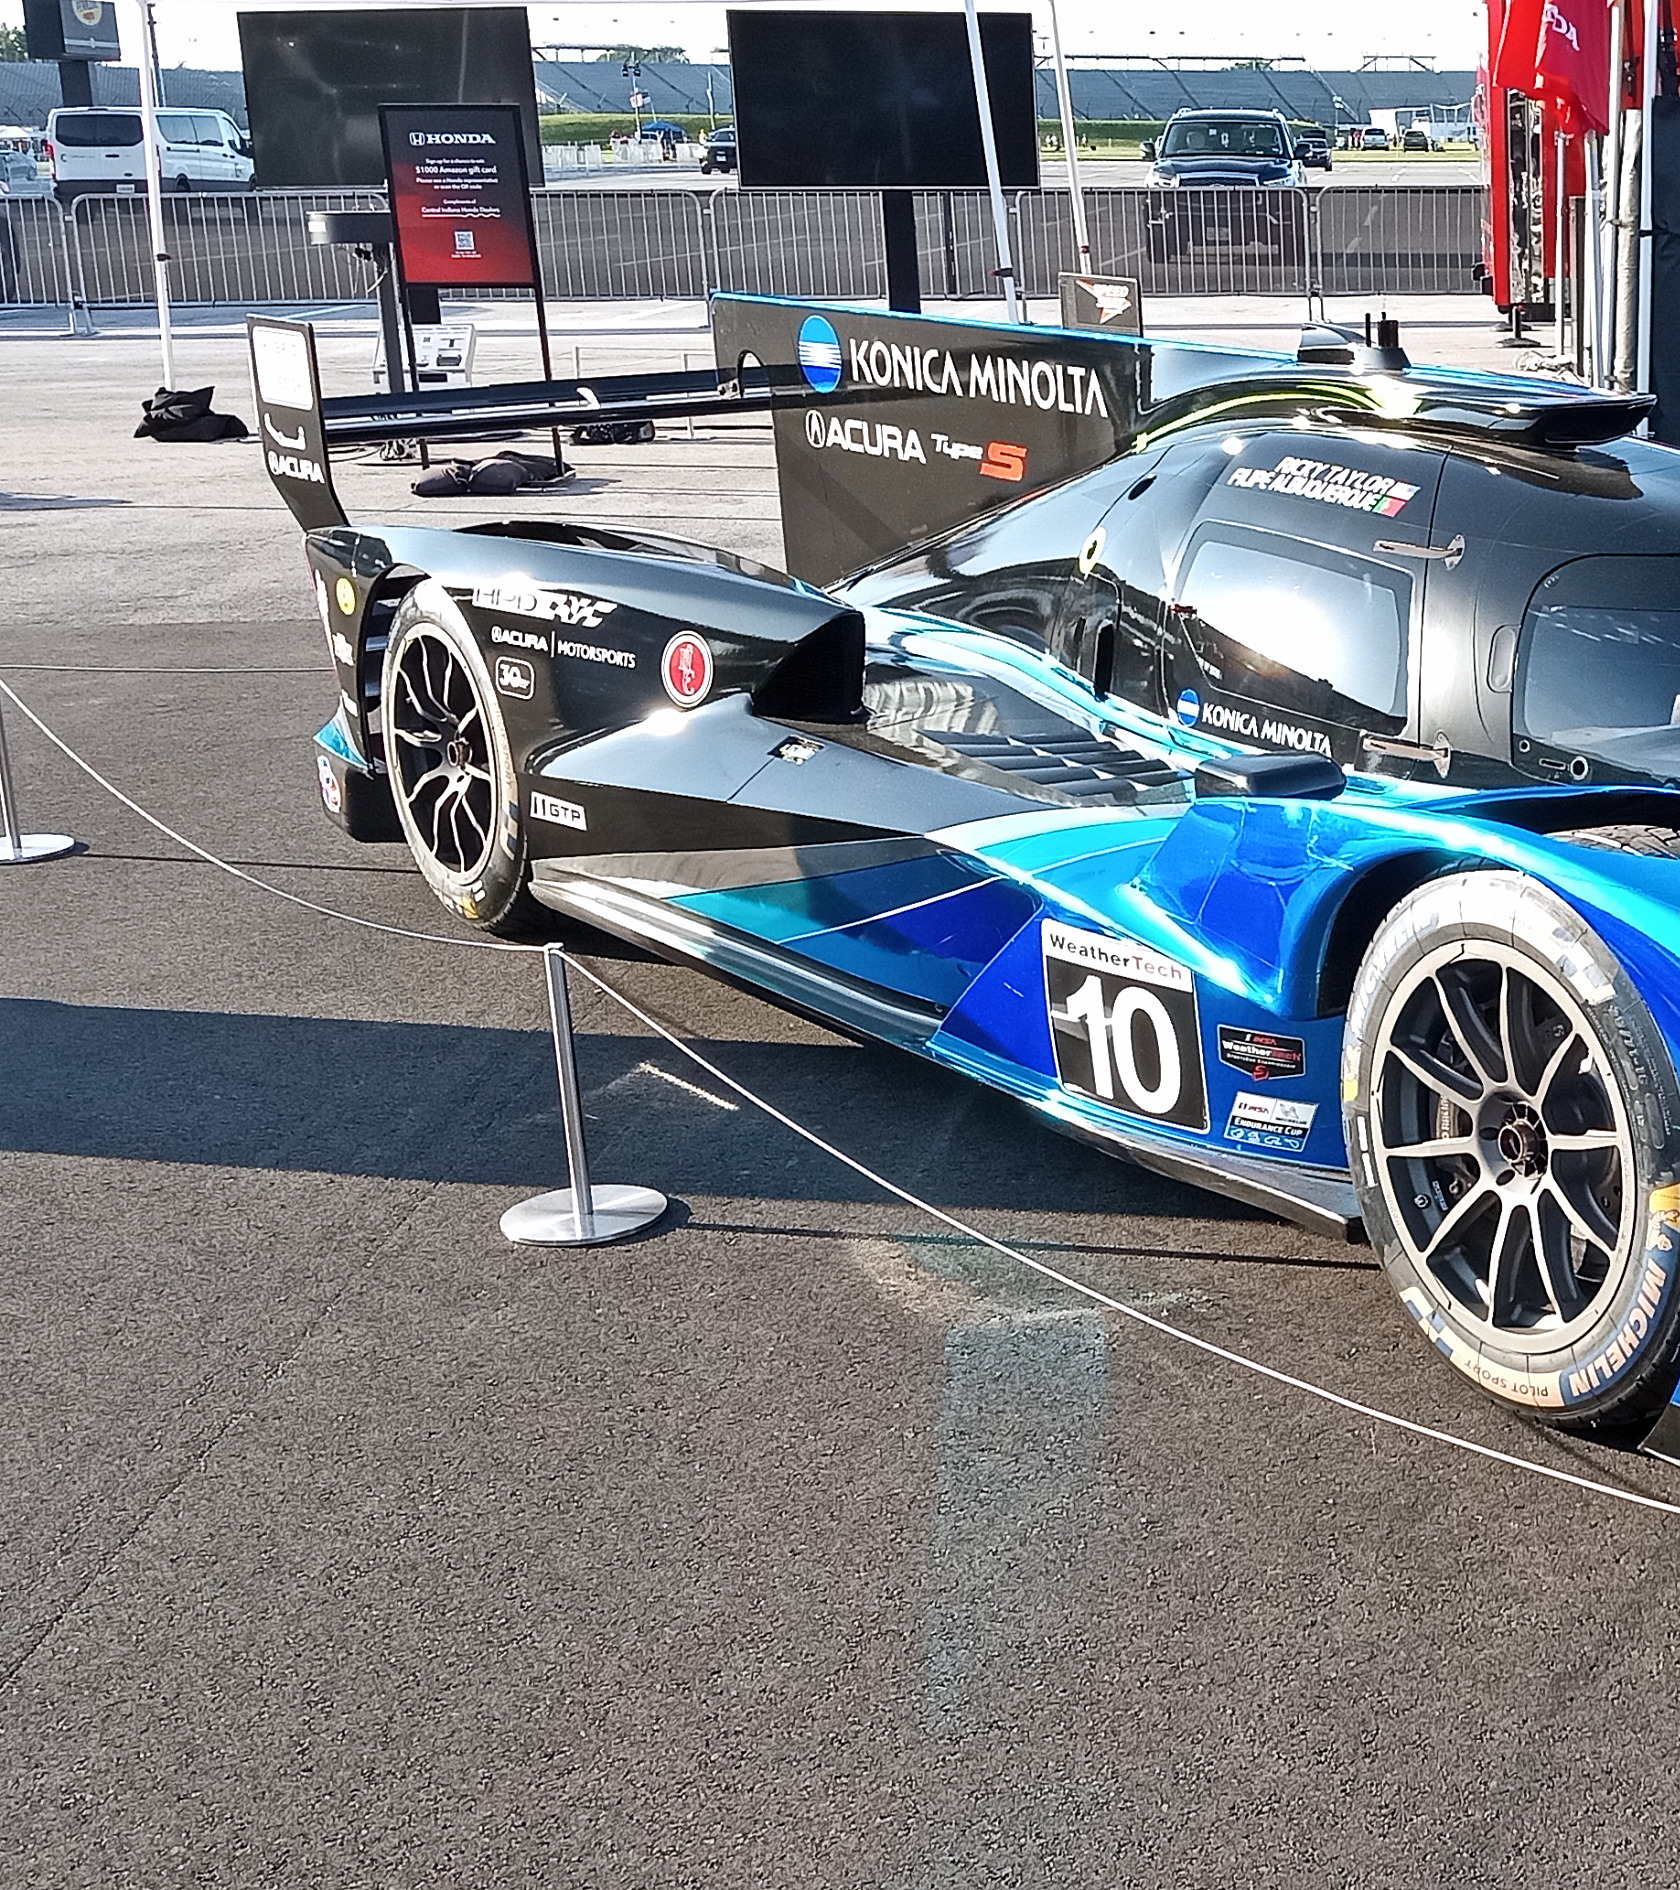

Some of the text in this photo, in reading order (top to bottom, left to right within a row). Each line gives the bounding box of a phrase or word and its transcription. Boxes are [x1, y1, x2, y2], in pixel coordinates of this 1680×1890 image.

[426, 133, 496, 144] HONDA
[415, 166, 438, 174] $1000
[468, 166, 480, 175] gift
[481, 165, 497, 174] card
[849, 338, 1109, 418] KONICA MINOLTA
[277, 452, 326, 484] ACURA
[825, 416, 1028, 482] ACURA Type S
[1227, 467, 1383, 512] FILIPE ALBUQUERQUE
[1274, 456, 1396, 496] RICKY TAYLOR
[474, 587, 539, 612] HPD
[500, 629, 637, 669] ACURA MOTORSPORTS
[1202, 702, 1333, 758] KONICA MINOLTA
[549, 804, 581, 822] GTP
[1049, 932, 1183, 981] WeatherTech
[1066, 974, 1182, 1115] 10
[1222, 1040, 1302, 1061] WeatherTech
[1568, 1255, 1666, 1398] MICHELIN
[1463, 1359, 1549, 1398] PILOT SPORT
